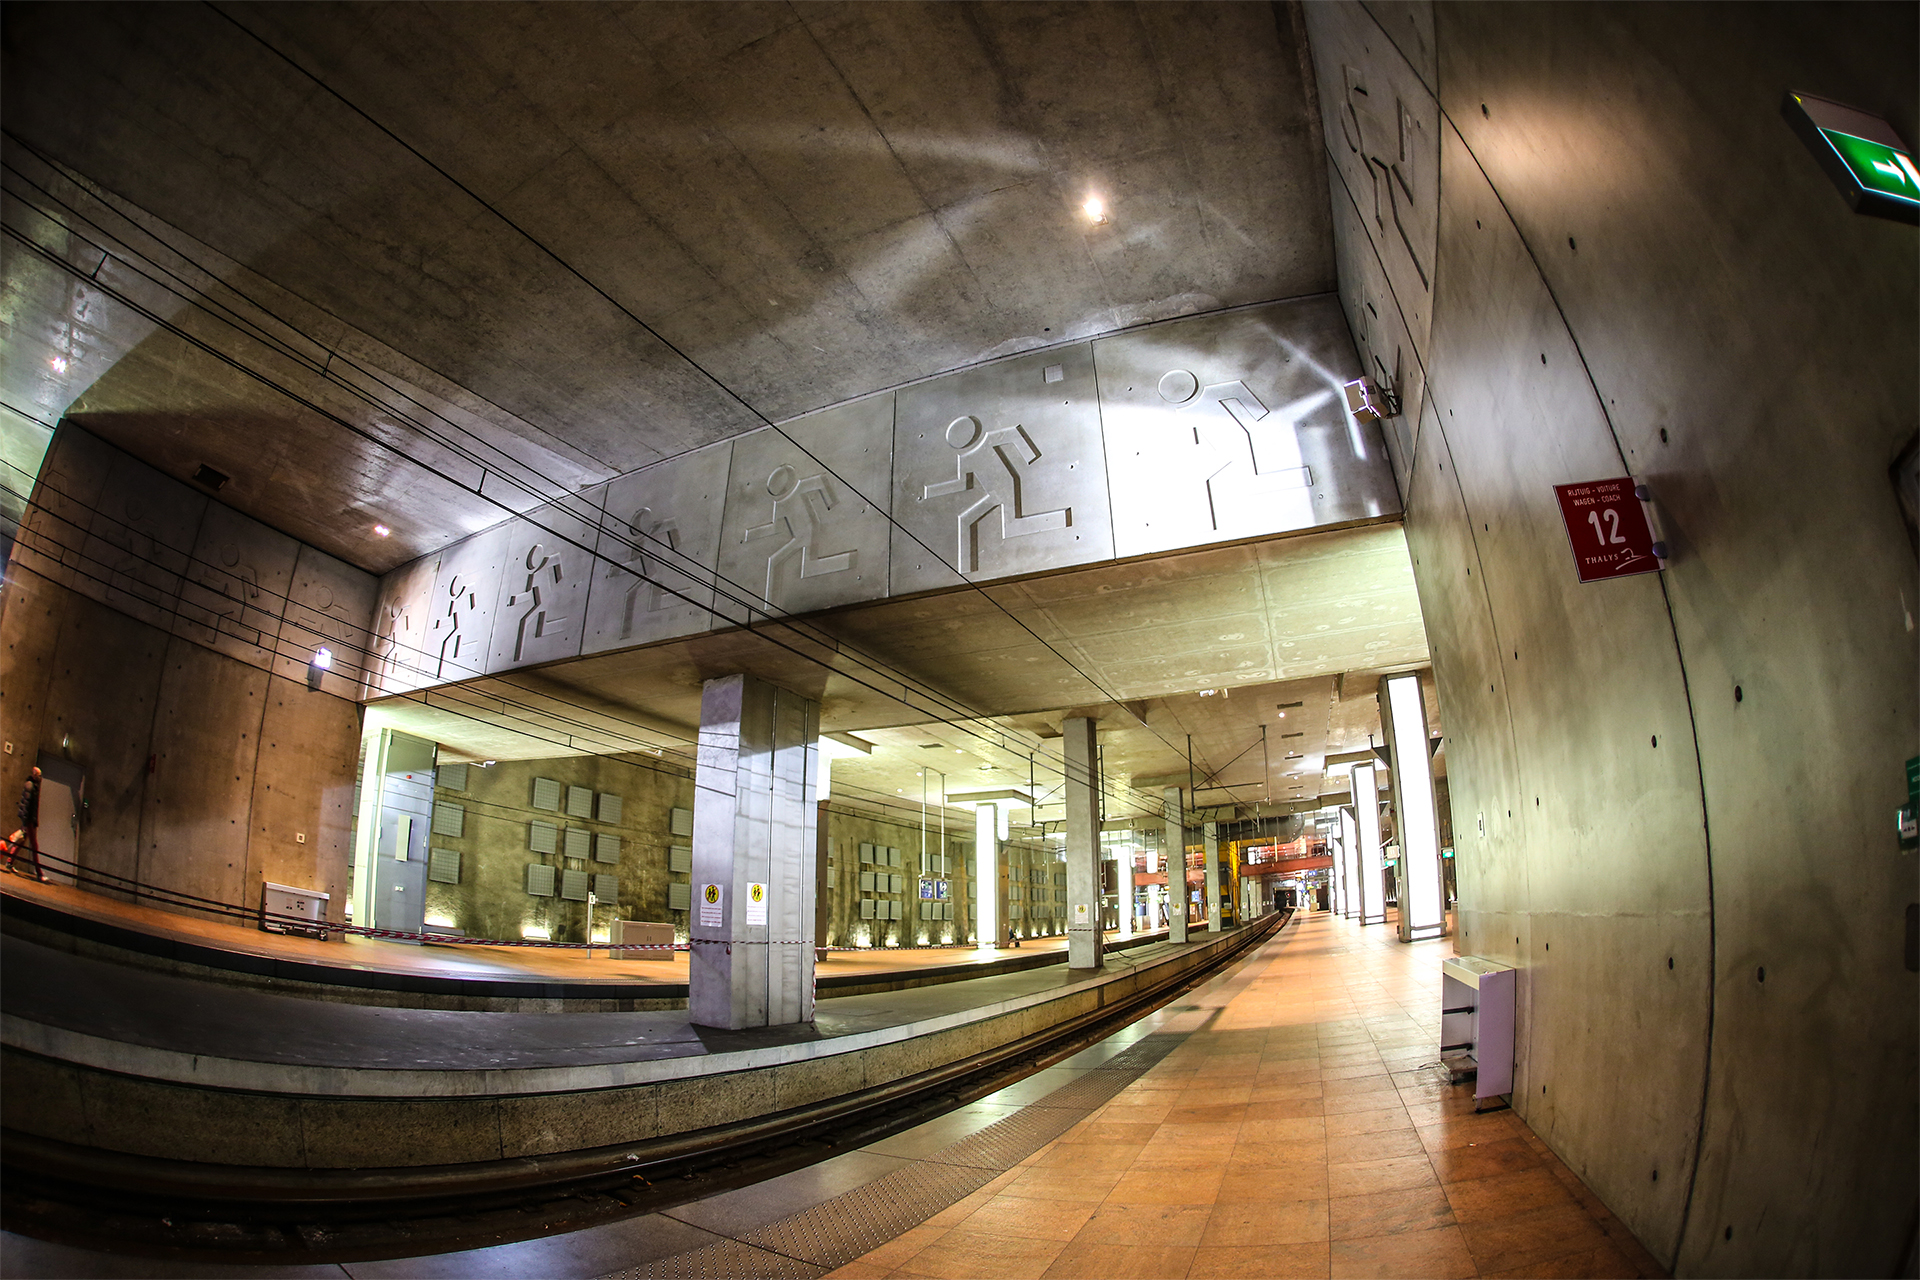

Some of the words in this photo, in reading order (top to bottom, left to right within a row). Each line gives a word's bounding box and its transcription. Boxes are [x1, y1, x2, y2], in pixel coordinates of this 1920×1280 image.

[1567, 487, 1591, 497] RIJTUIG
[1596, 483, 1621, 493] VOITURE
[1573, 497, 1596, 506] WAGEN
[1601, 494, 1621, 503] COACH
[1588, 508, 1626, 546] 12
[1585, 553, 1619, 565] THALYS
